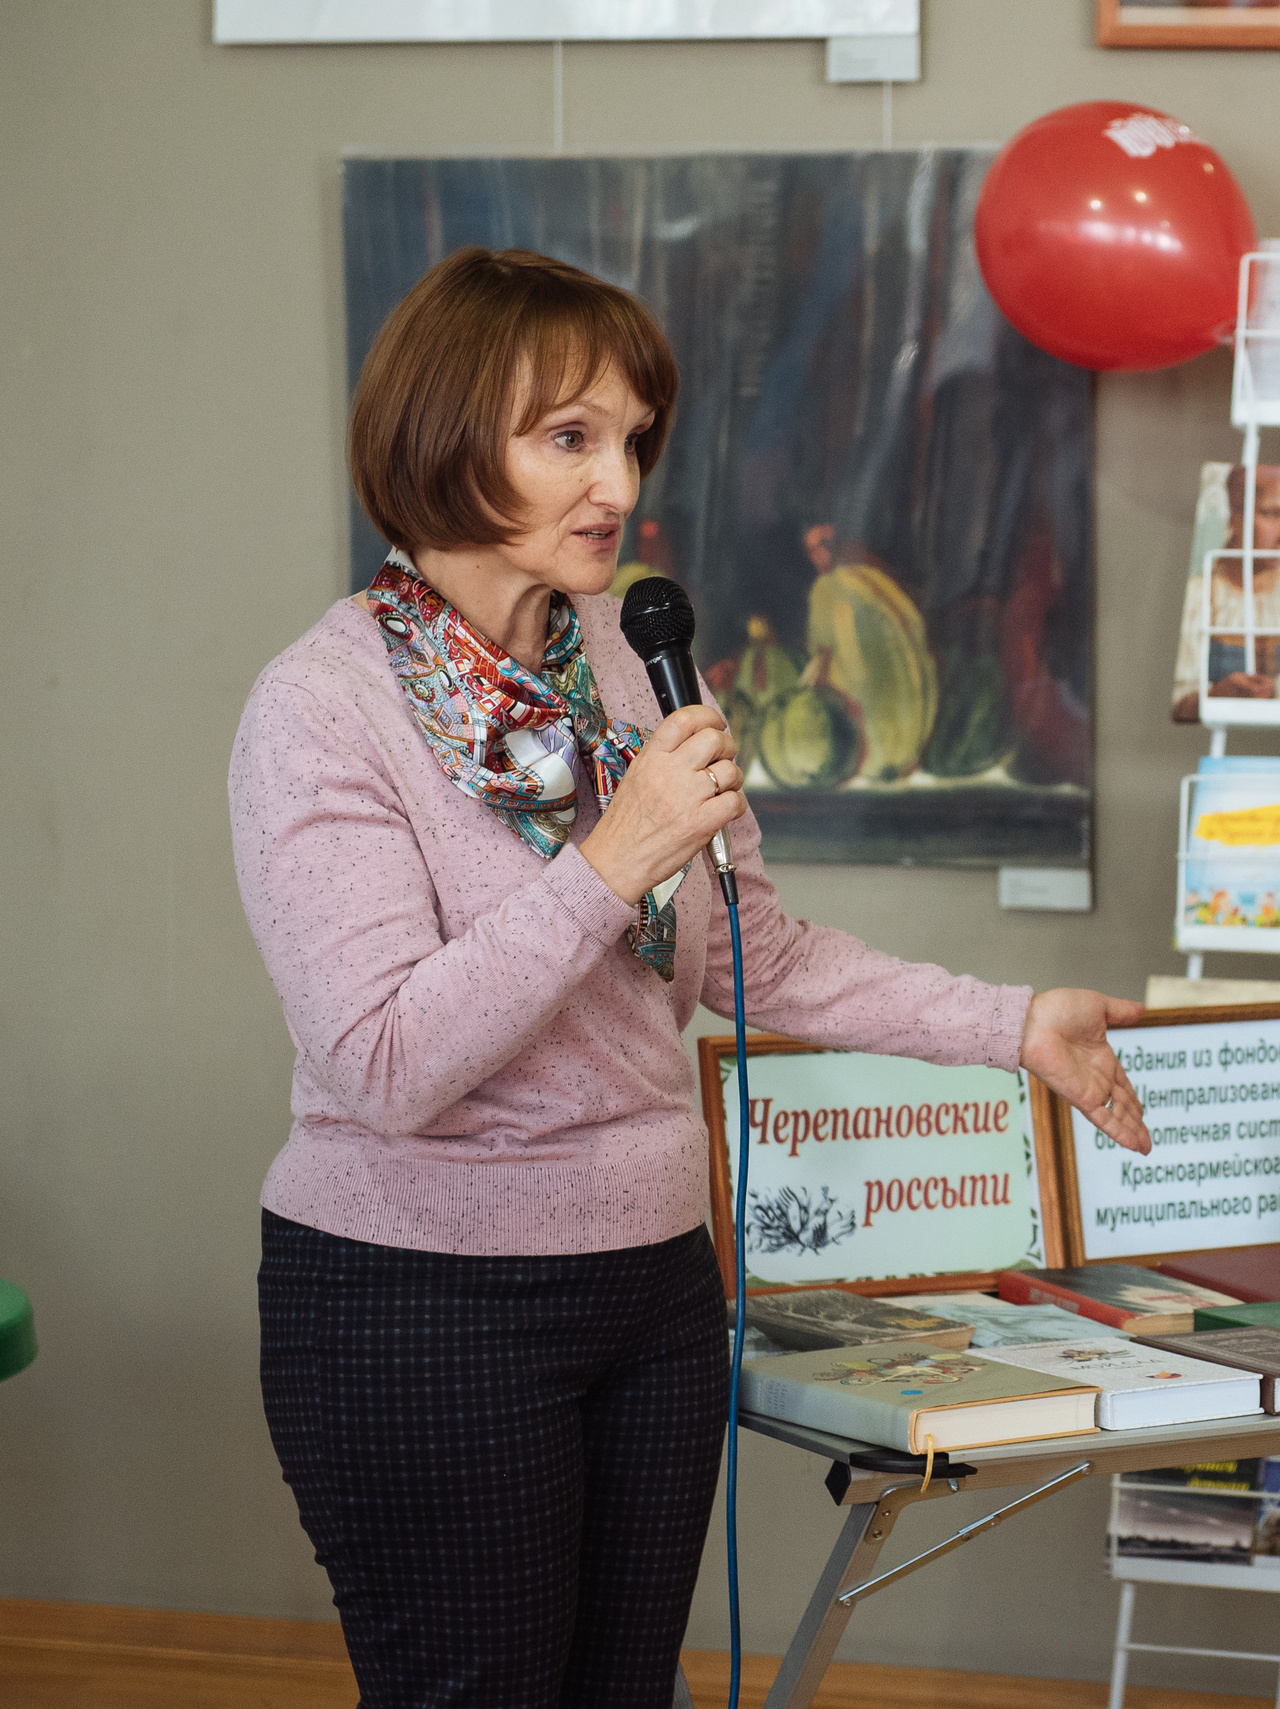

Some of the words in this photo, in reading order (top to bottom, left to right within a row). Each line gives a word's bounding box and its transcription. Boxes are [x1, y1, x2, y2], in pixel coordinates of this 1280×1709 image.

[1193, 1050, 1213, 1068] из
[748, 1098, 1010, 1157] Черепановские
[1095, 1121, 1231, 1150] биотечная
[862, 1172, 1012, 1228] россыпи
[1096, 1196, 1251, 1232] муниципального
